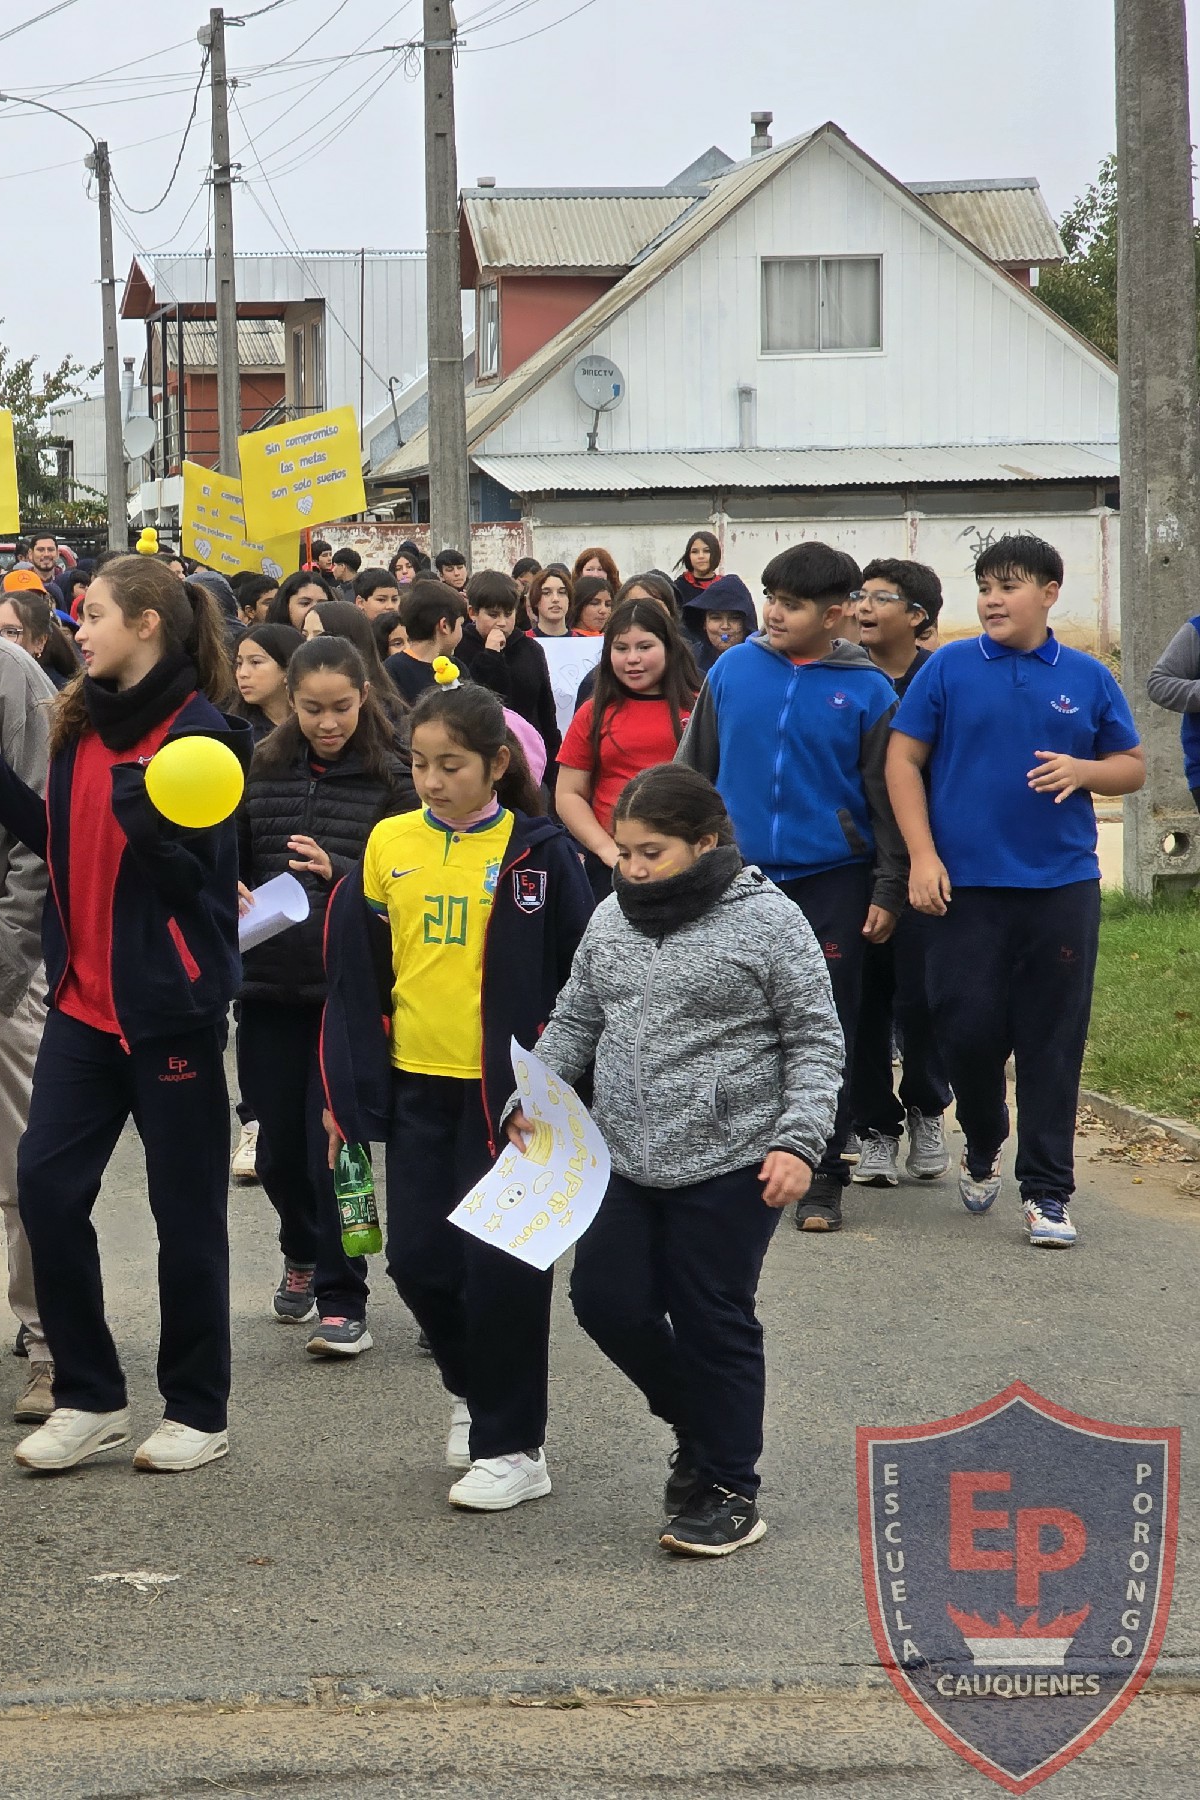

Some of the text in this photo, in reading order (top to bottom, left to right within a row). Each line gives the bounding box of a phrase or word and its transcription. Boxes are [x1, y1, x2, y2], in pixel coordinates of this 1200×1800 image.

[582, 368, 614, 377] DIRECTV
[265, 426, 339, 455] Sin compromiso
[280, 452, 327, 474] las metas
[272, 469, 346, 498] son solo sueños
[521, 874, 536, 892] EP
[423, 895, 469, 947] 20
[168, 1056, 188, 1073] EP
